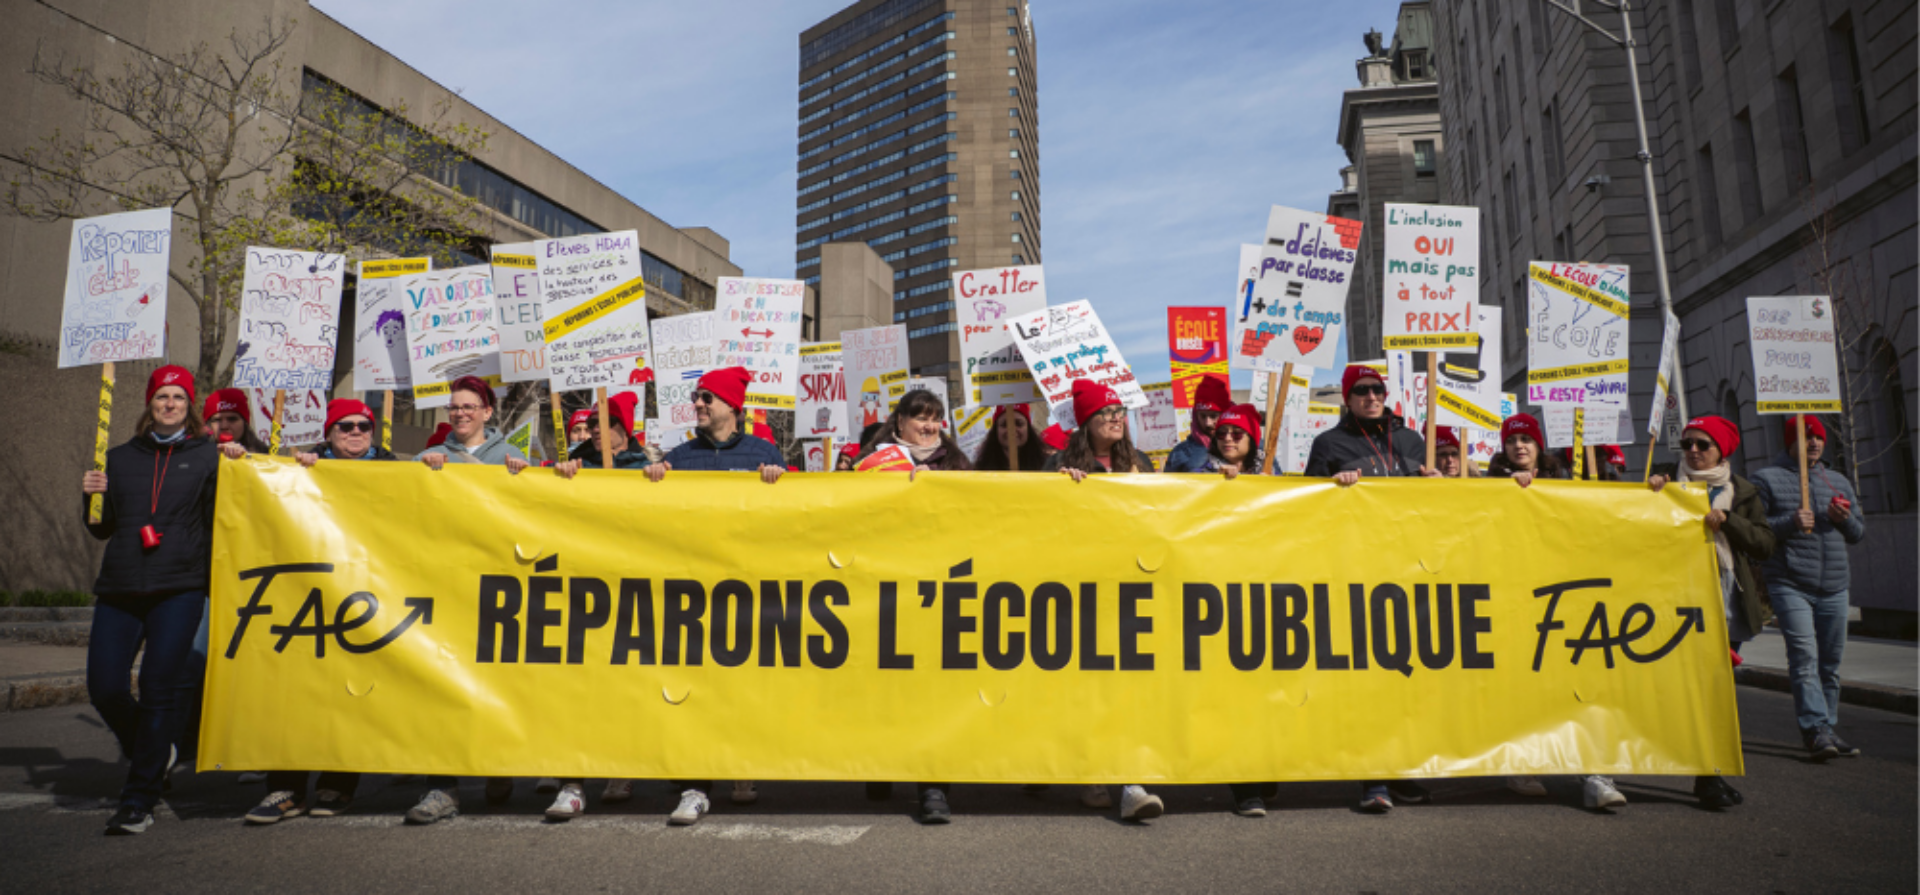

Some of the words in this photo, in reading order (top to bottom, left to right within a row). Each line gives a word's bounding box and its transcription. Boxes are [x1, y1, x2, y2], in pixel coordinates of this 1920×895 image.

[1388, 208, 1463, 228] L'inclusion
[78, 224, 171, 280] Réparer
[595, 237, 631, 252] HDAA
[1286, 221, 1355, 263] d'élèves
[1414, 235, 1455, 256] OUI
[543, 264, 563, 275] des
[566, 258, 613, 275] services
[1260, 256, 1294, 279] par
[1296, 259, 1345, 284] classe
[1388, 257, 1439, 276] mais
[1446, 264, 1476, 283] pas
[959, 268, 1039, 299] Gratter
[1397, 282, 1410, 300] à
[1419, 282, 1456, 300] tout
[406, 278, 494, 310] VALORISER
[563, 306, 594, 328] RÉPARONS
[616, 281, 644, 302] PUBLIQUE
[1267, 299, 1287, 317] de
[1294, 301, 1341, 332] temps
[964, 324, 993, 342] pour
[1015, 322, 1041, 341] Le
[1175, 314, 1219, 341] ÉCOLE
[1256, 320, 1289, 340] par
[1389, 336, 1418, 347] RÉPARONS
[1441, 335, 1467, 345] PUBLIQUE
[715, 354, 754, 366] POUR
[760, 357, 779, 369] LA
[1764, 350, 1812, 369] POUR
[1065, 364, 1087, 379] des
[1529, 385, 1546, 403] LE
[1549, 386, 1586, 404] RESTE
[477, 554, 849, 668] RÉPARONS
[879, 559, 1154, 670] L'ÉCOLE
[1183, 583, 1494, 677] PUBLIQUE
